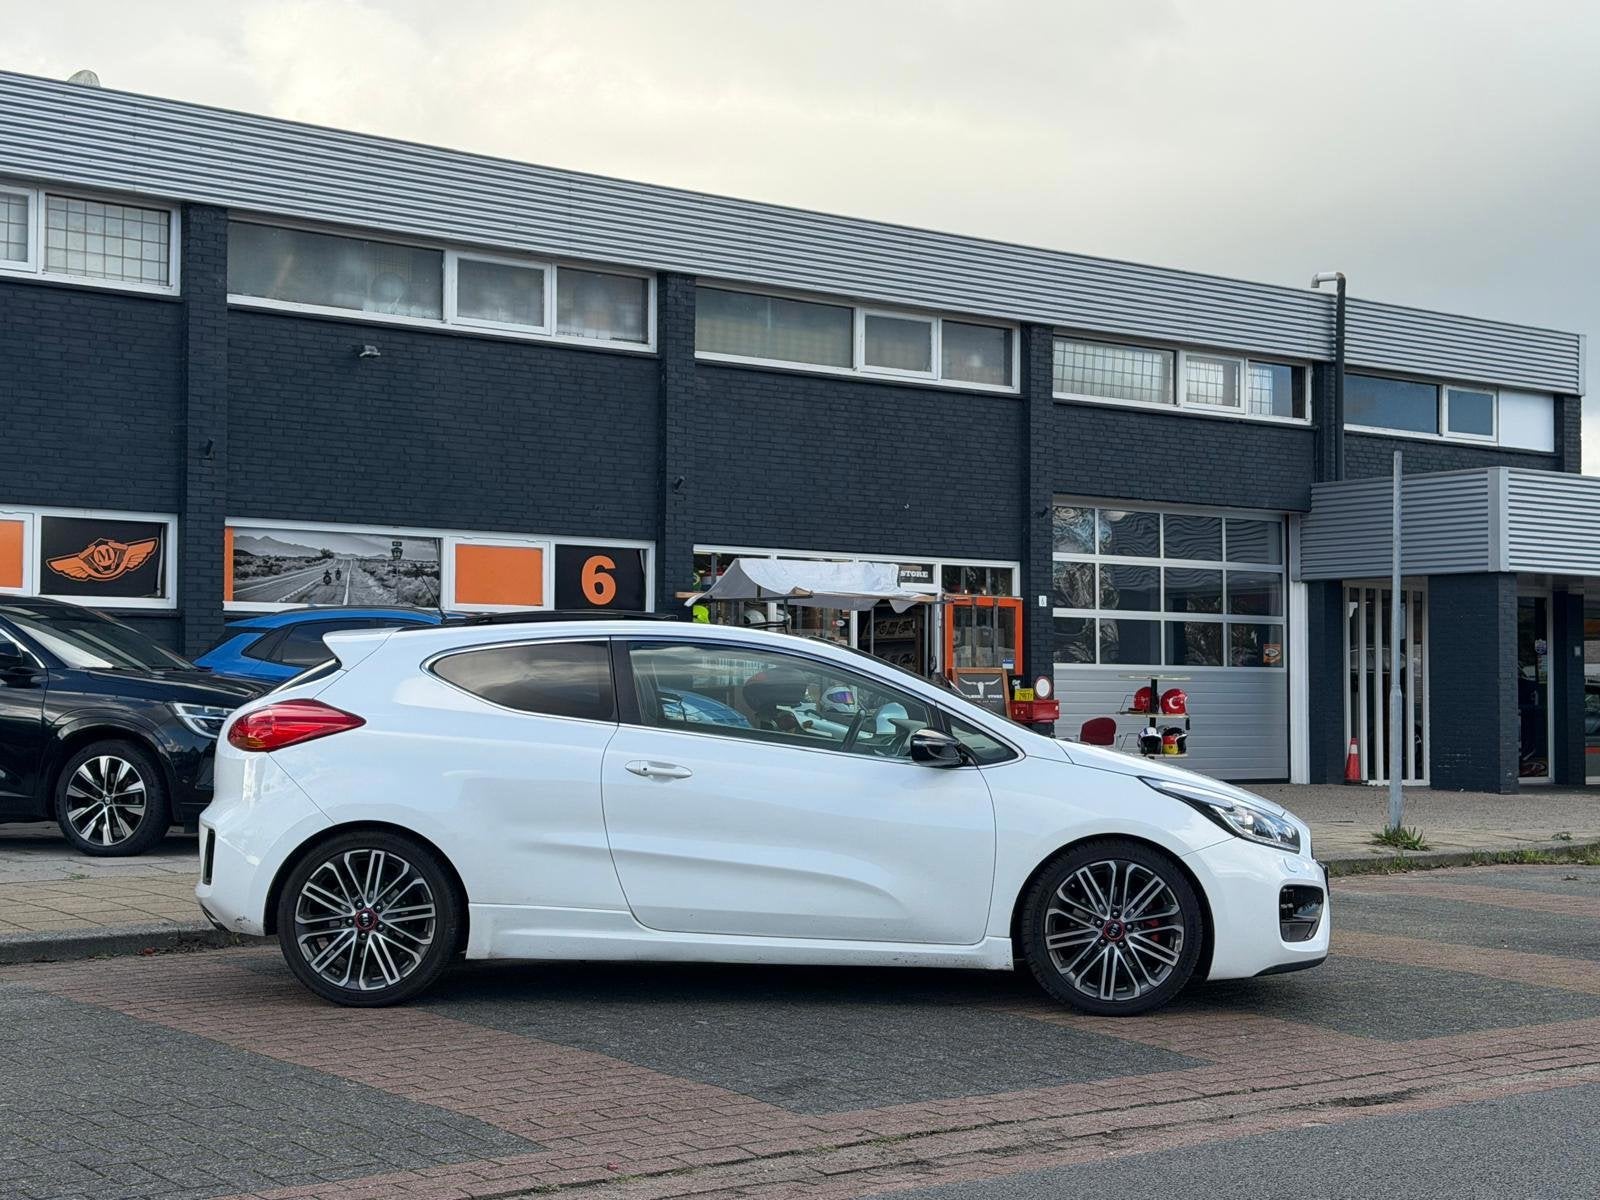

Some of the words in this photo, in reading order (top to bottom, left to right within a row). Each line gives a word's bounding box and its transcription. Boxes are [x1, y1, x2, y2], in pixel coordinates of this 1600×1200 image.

[98, 549, 112, 563] M
[581, 555, 616, 605] 6
[900, 570, 929, 578] STORE
